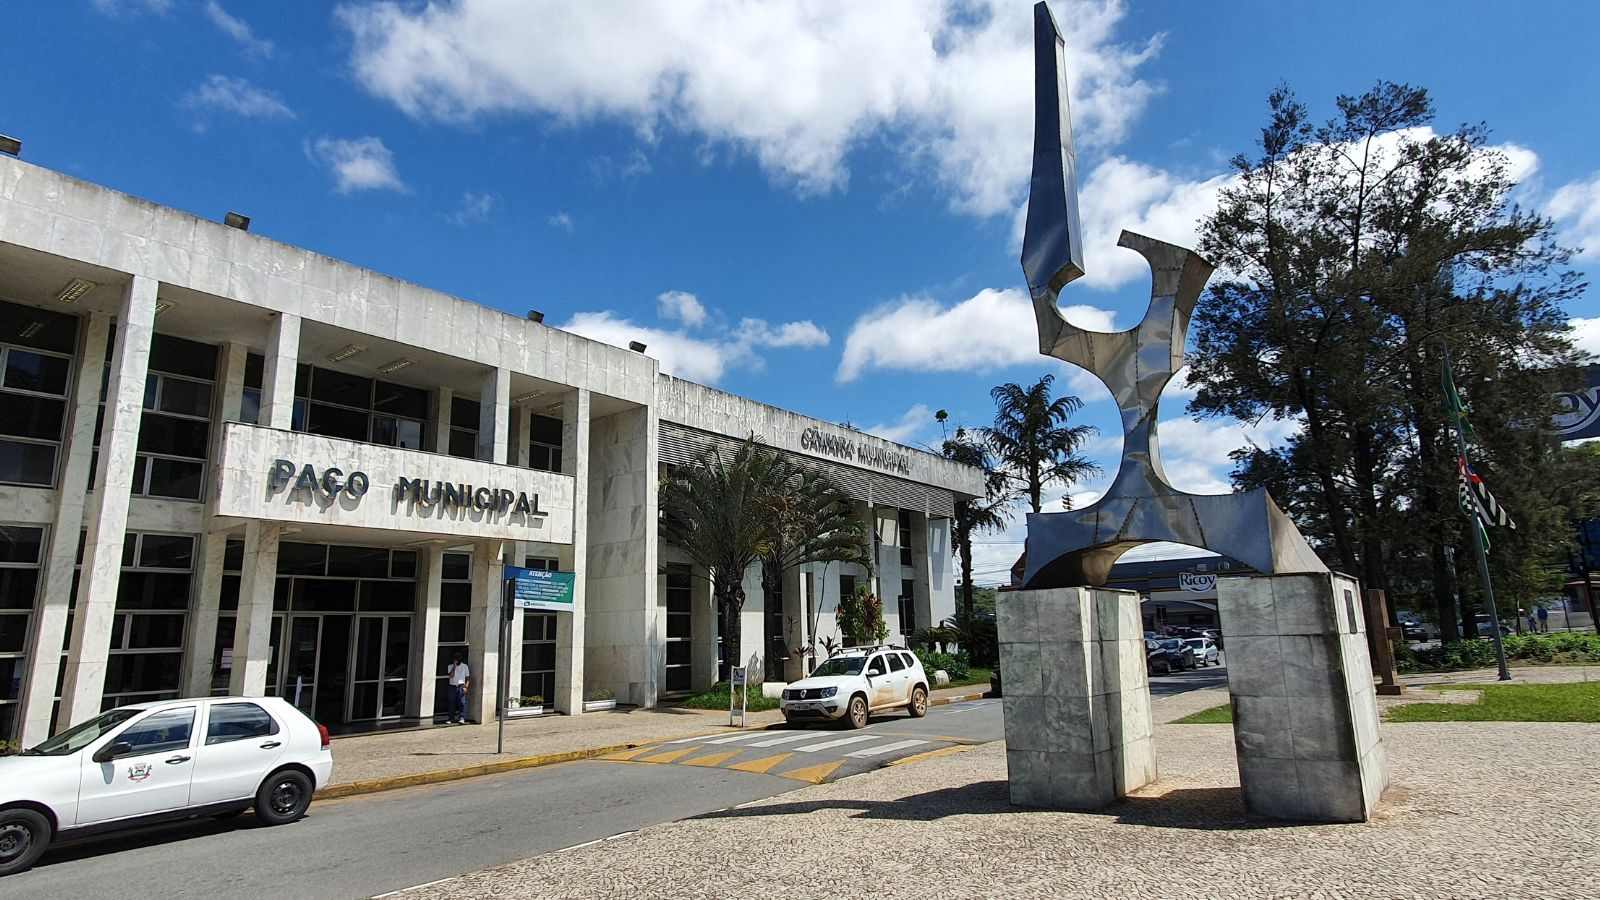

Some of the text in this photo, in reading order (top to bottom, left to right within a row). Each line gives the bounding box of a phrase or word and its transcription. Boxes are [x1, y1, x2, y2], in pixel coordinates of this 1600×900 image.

[857, 443, 912, 475] MUNICIPAL
[271, 458, 548, 517] PAÇO MUNICIPAL
[1180, 573, 1216, 588] Ricoy
